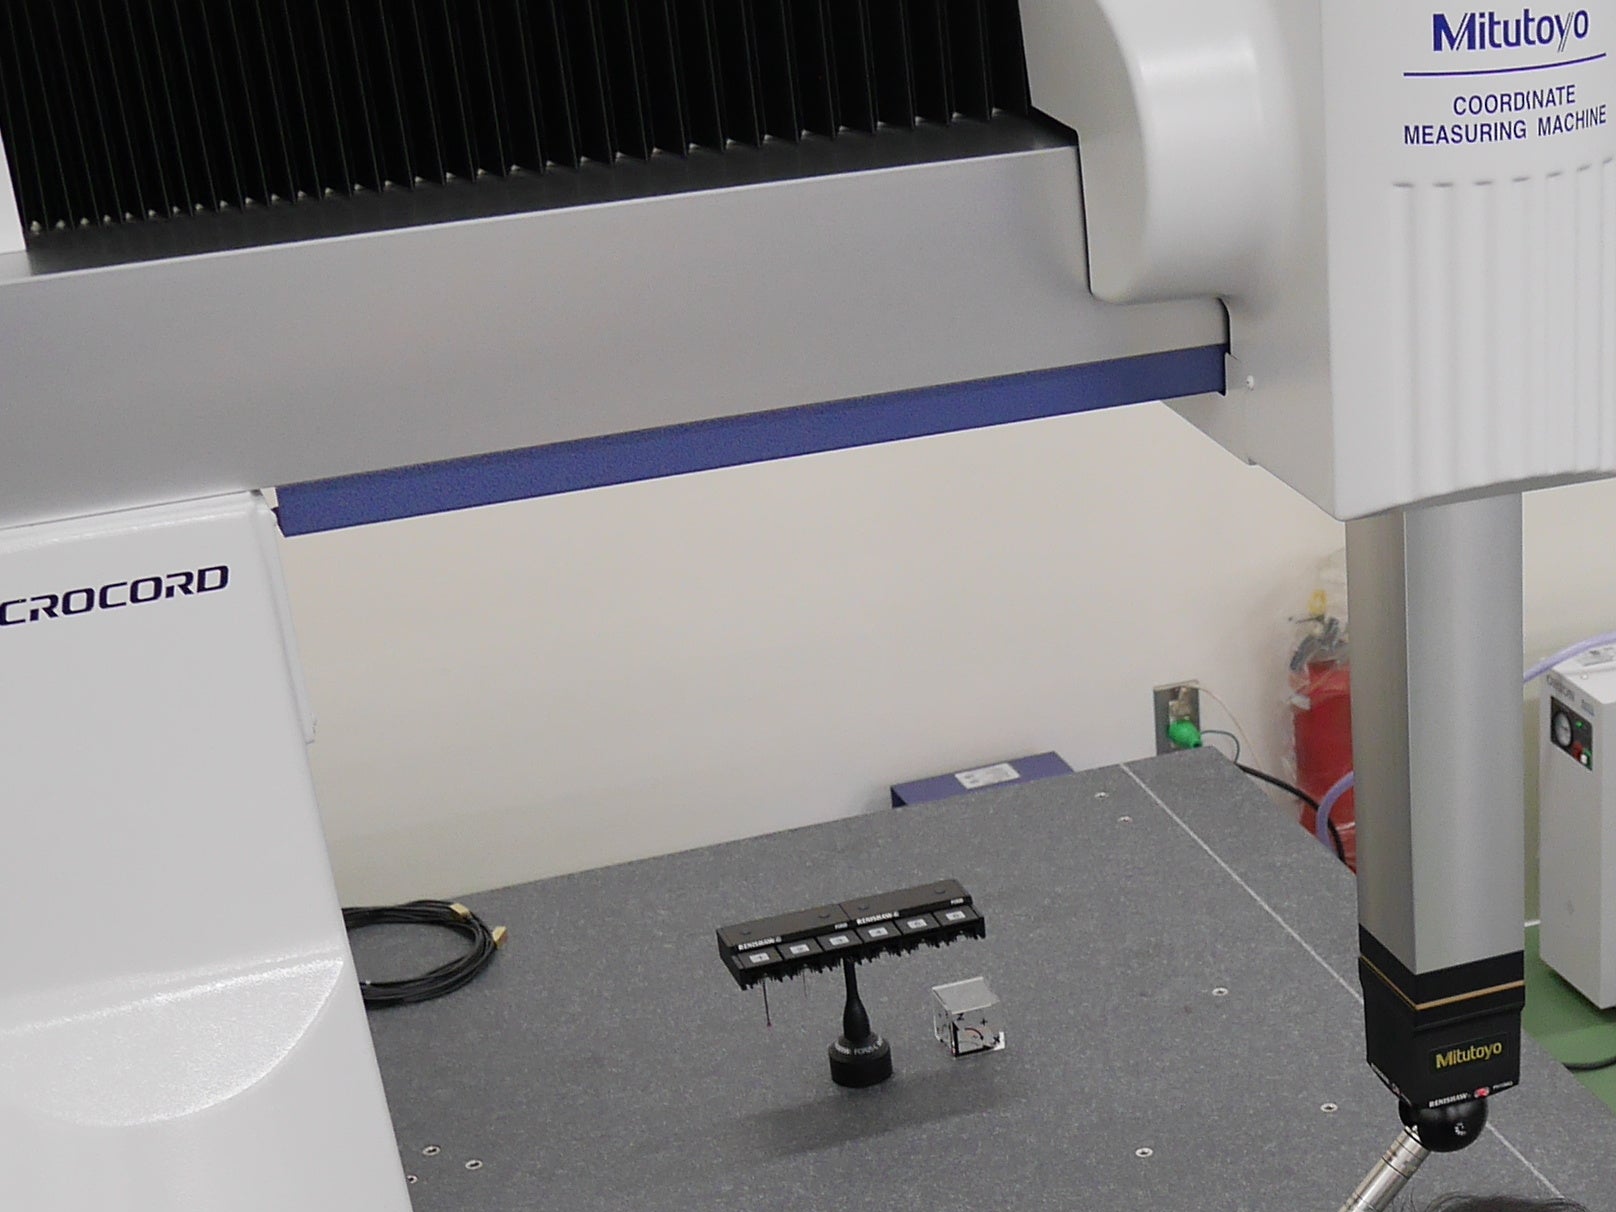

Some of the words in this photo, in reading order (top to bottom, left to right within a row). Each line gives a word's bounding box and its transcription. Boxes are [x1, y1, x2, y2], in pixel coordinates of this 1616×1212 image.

[1433, 9, 1589, 52] Mitutoyo
[1453, 84, 1576, 117] COORDINATE
[1403, 119, 1527, 145] MEASURING
[1537, 104, 1607, 137] MACHINE
[1435, 1042, 1503, 1069] Mitutoyo
[1428, 1092, 1469, 1108] RENISHAW
